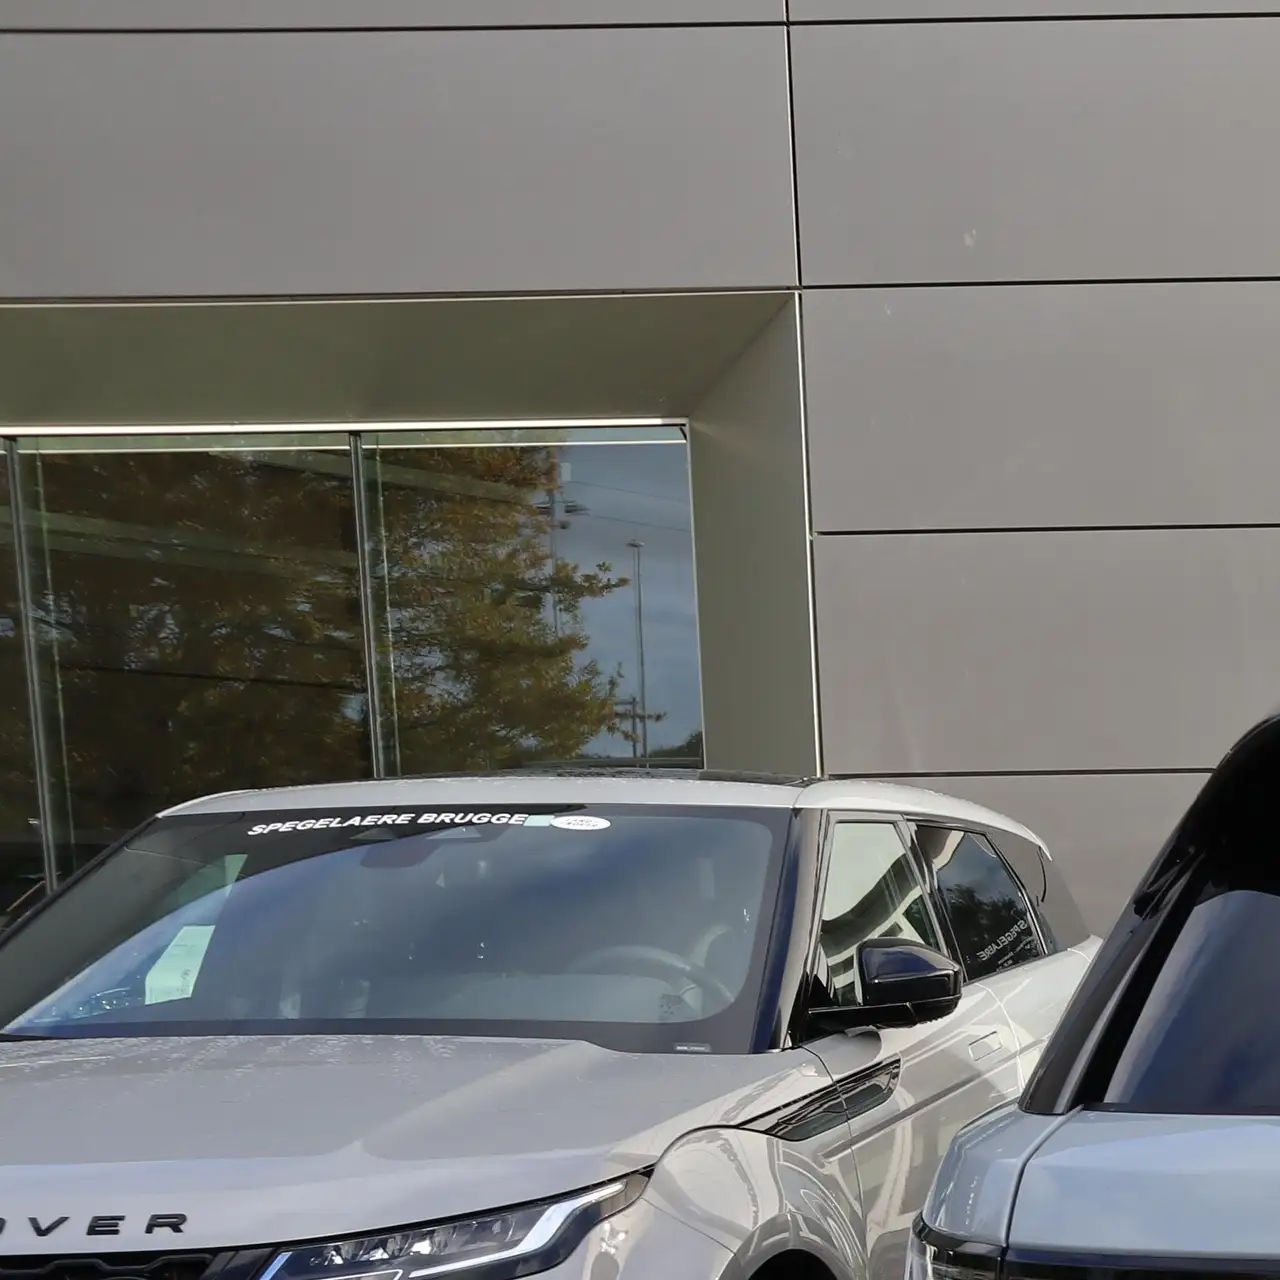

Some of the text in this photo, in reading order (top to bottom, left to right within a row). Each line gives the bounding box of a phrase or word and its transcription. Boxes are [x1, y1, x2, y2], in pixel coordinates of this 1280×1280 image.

[247, 812, 528, 836] SPEGELAERE BRUGGE
[0, 1213, 188, 1237] VER
